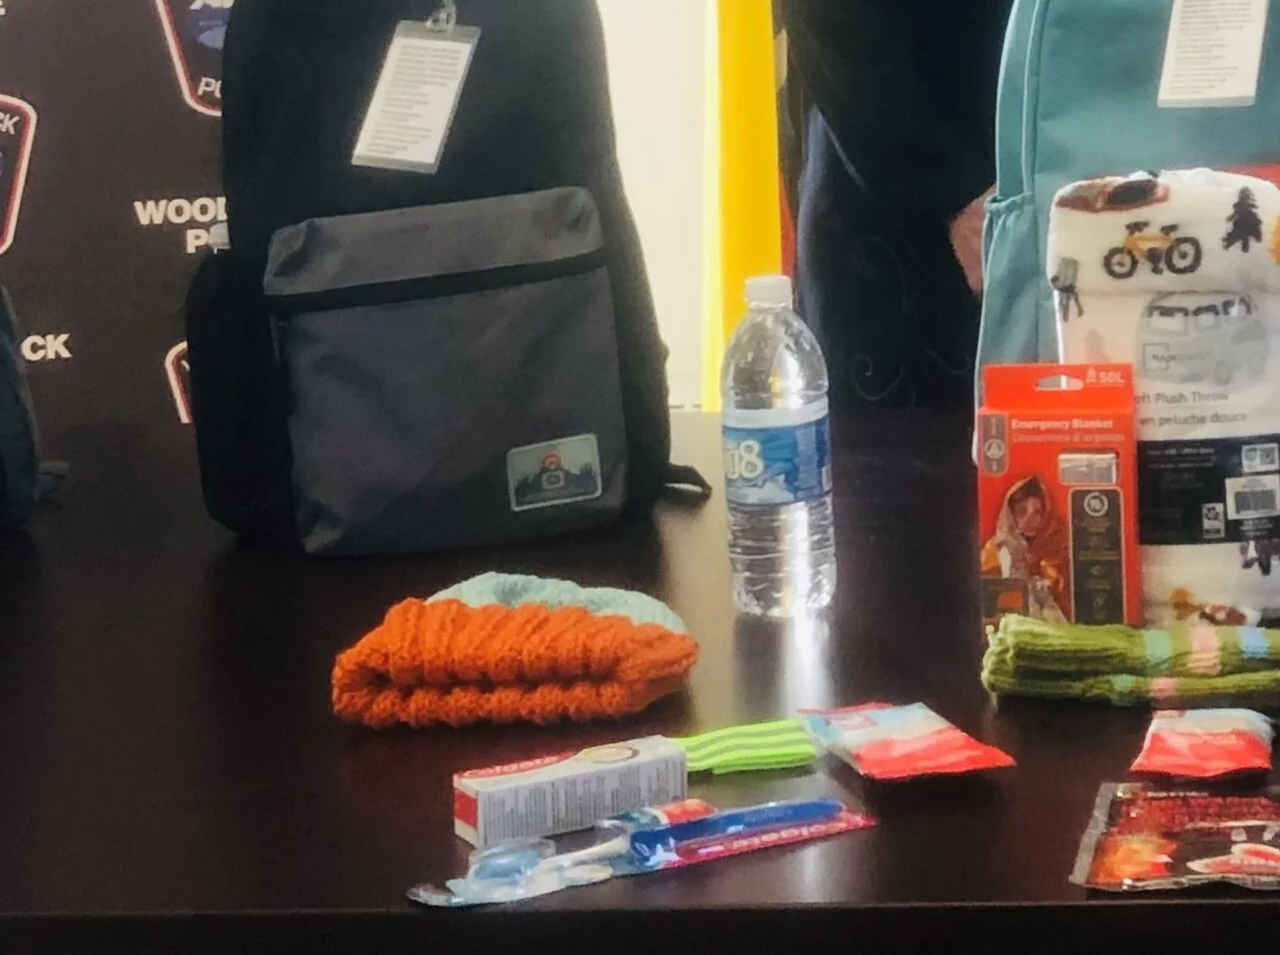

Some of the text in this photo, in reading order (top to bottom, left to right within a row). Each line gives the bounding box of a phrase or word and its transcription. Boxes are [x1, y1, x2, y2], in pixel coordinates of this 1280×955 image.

[1098, 371, 1124, 384] SOL
[1011, 418, 1113, 432] Emergency Blanket
